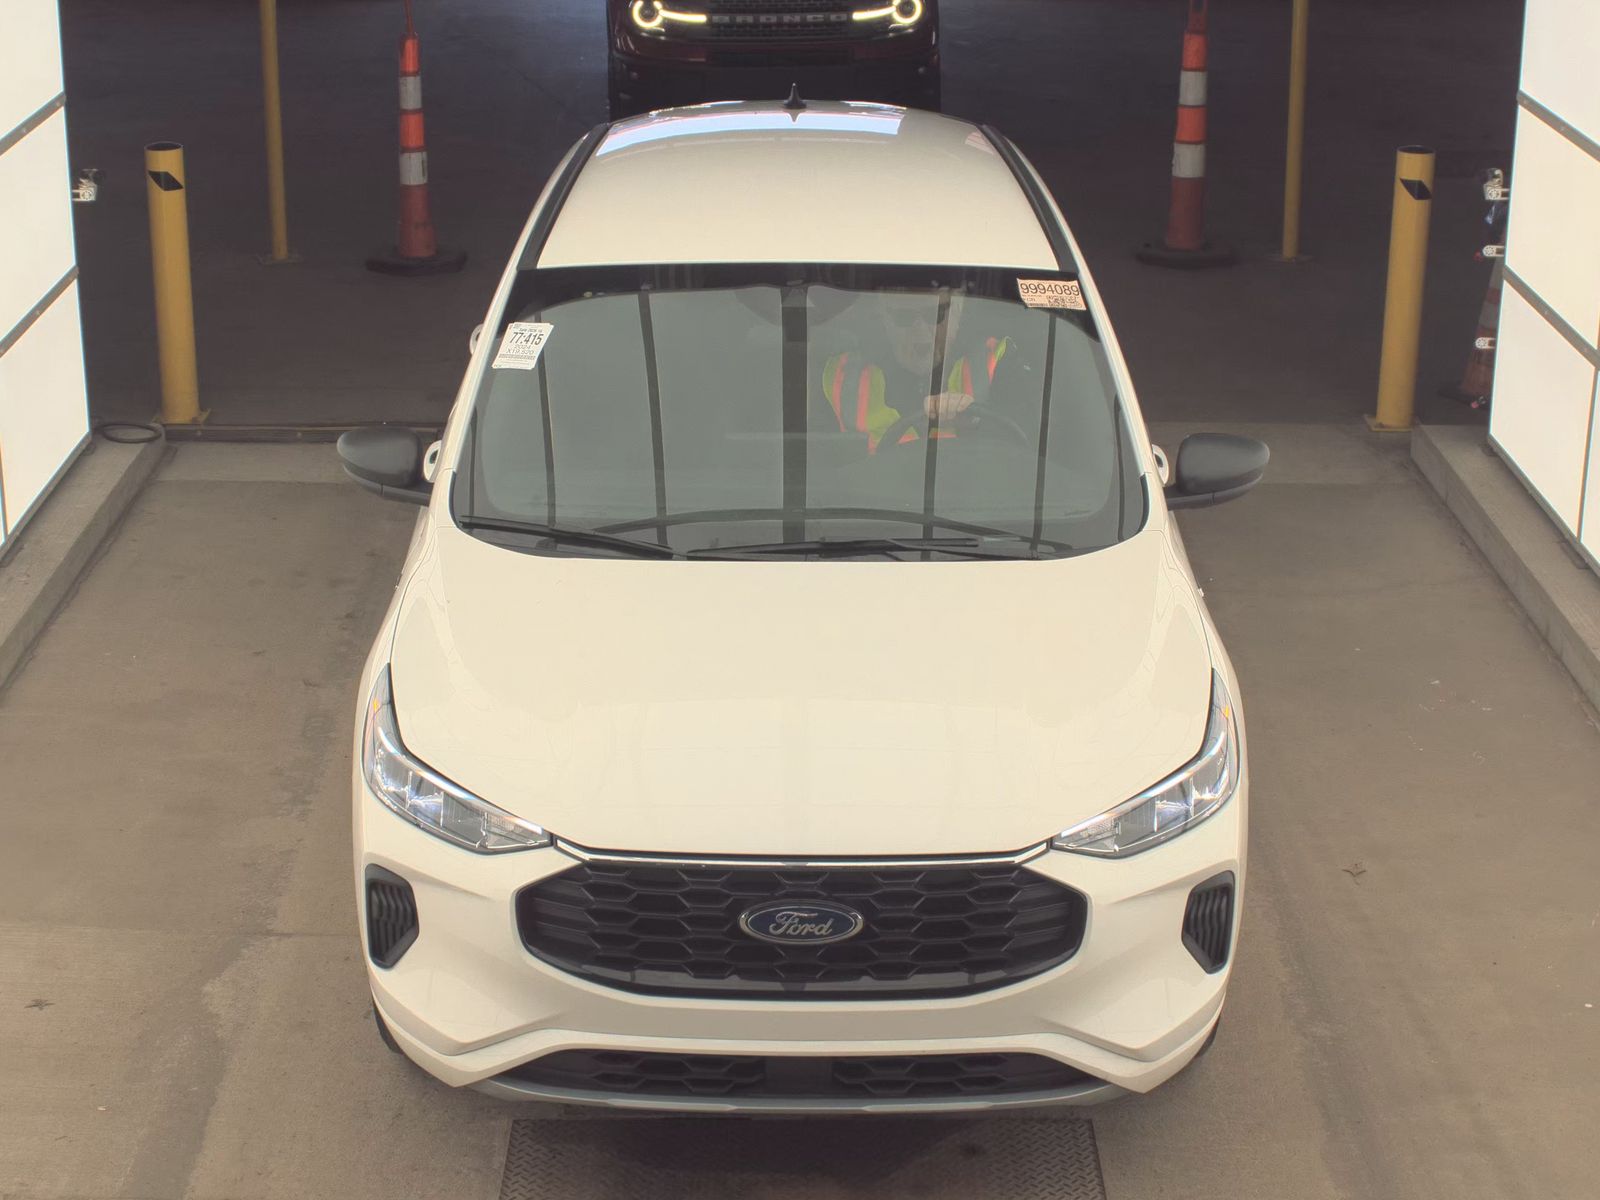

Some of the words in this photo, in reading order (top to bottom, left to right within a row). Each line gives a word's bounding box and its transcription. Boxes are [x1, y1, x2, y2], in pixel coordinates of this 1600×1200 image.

[711, 14, 848, 24] BRONCO
[1020, 283, 1080, 296] 9994089
[510, 332, 544, 345] 77:415
[769, 911, 834, 936] Ford
